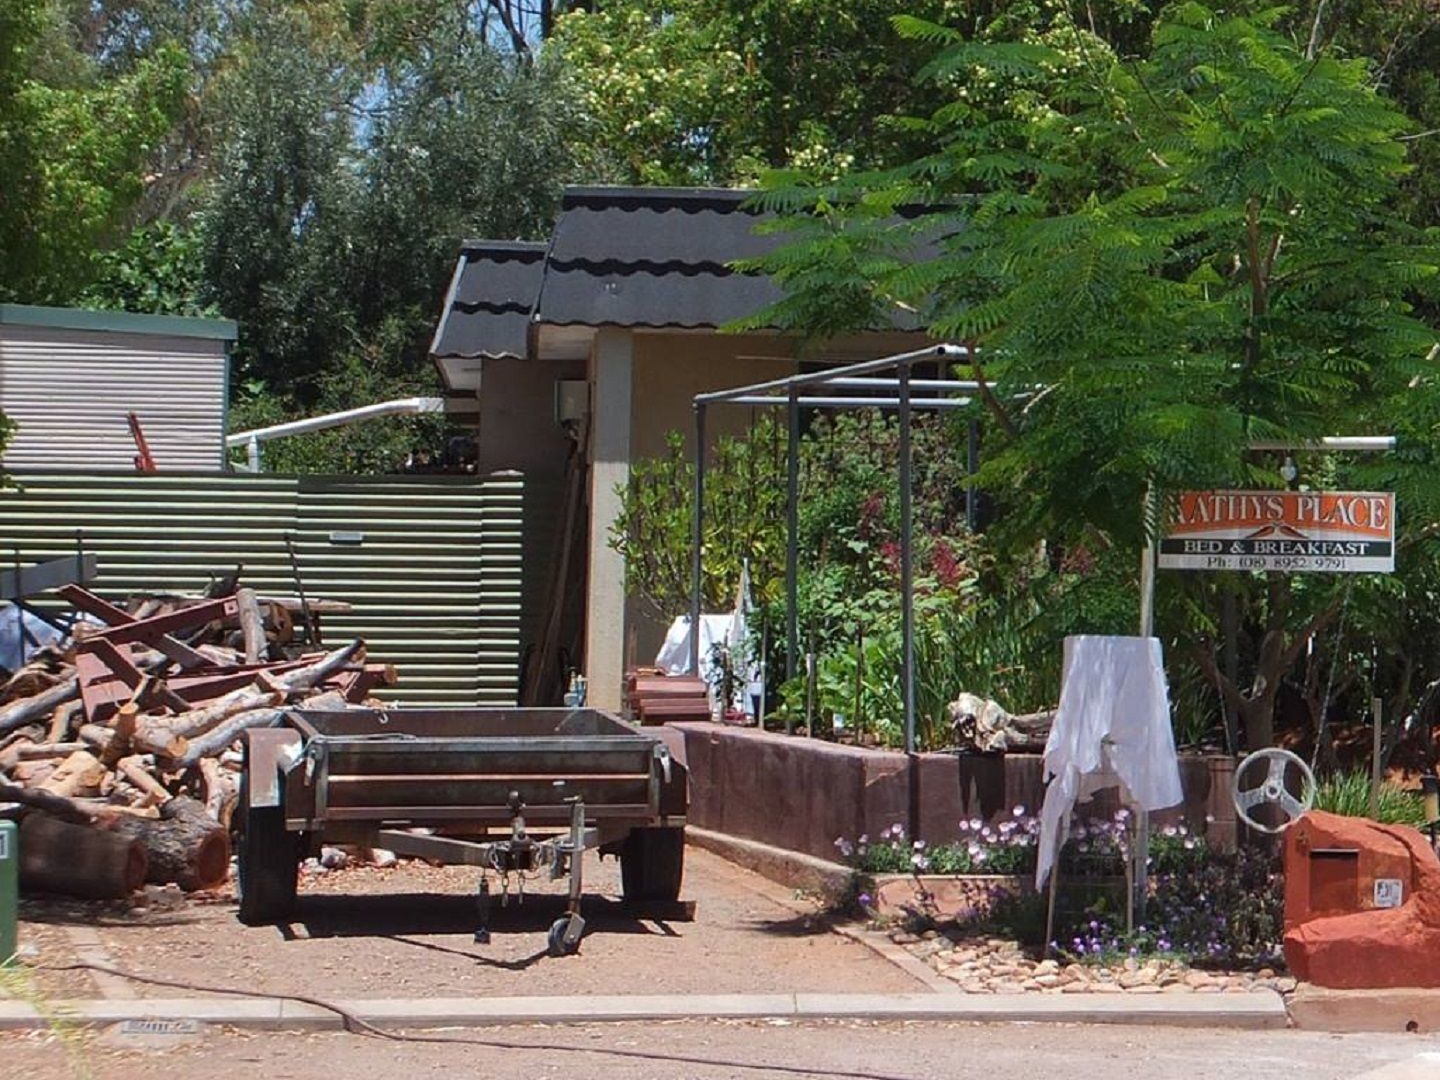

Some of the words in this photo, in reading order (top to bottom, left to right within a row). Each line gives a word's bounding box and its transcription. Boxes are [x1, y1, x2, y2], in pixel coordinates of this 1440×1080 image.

[1297, 495, 1387, 530] PLACE
[1184, 540, 1223, 553] BED
[1230, 541, 1246, 554] &
[1254, 541, 1370, 555] BREAKFAST
[1274, 558, 1306, 569] 8952
